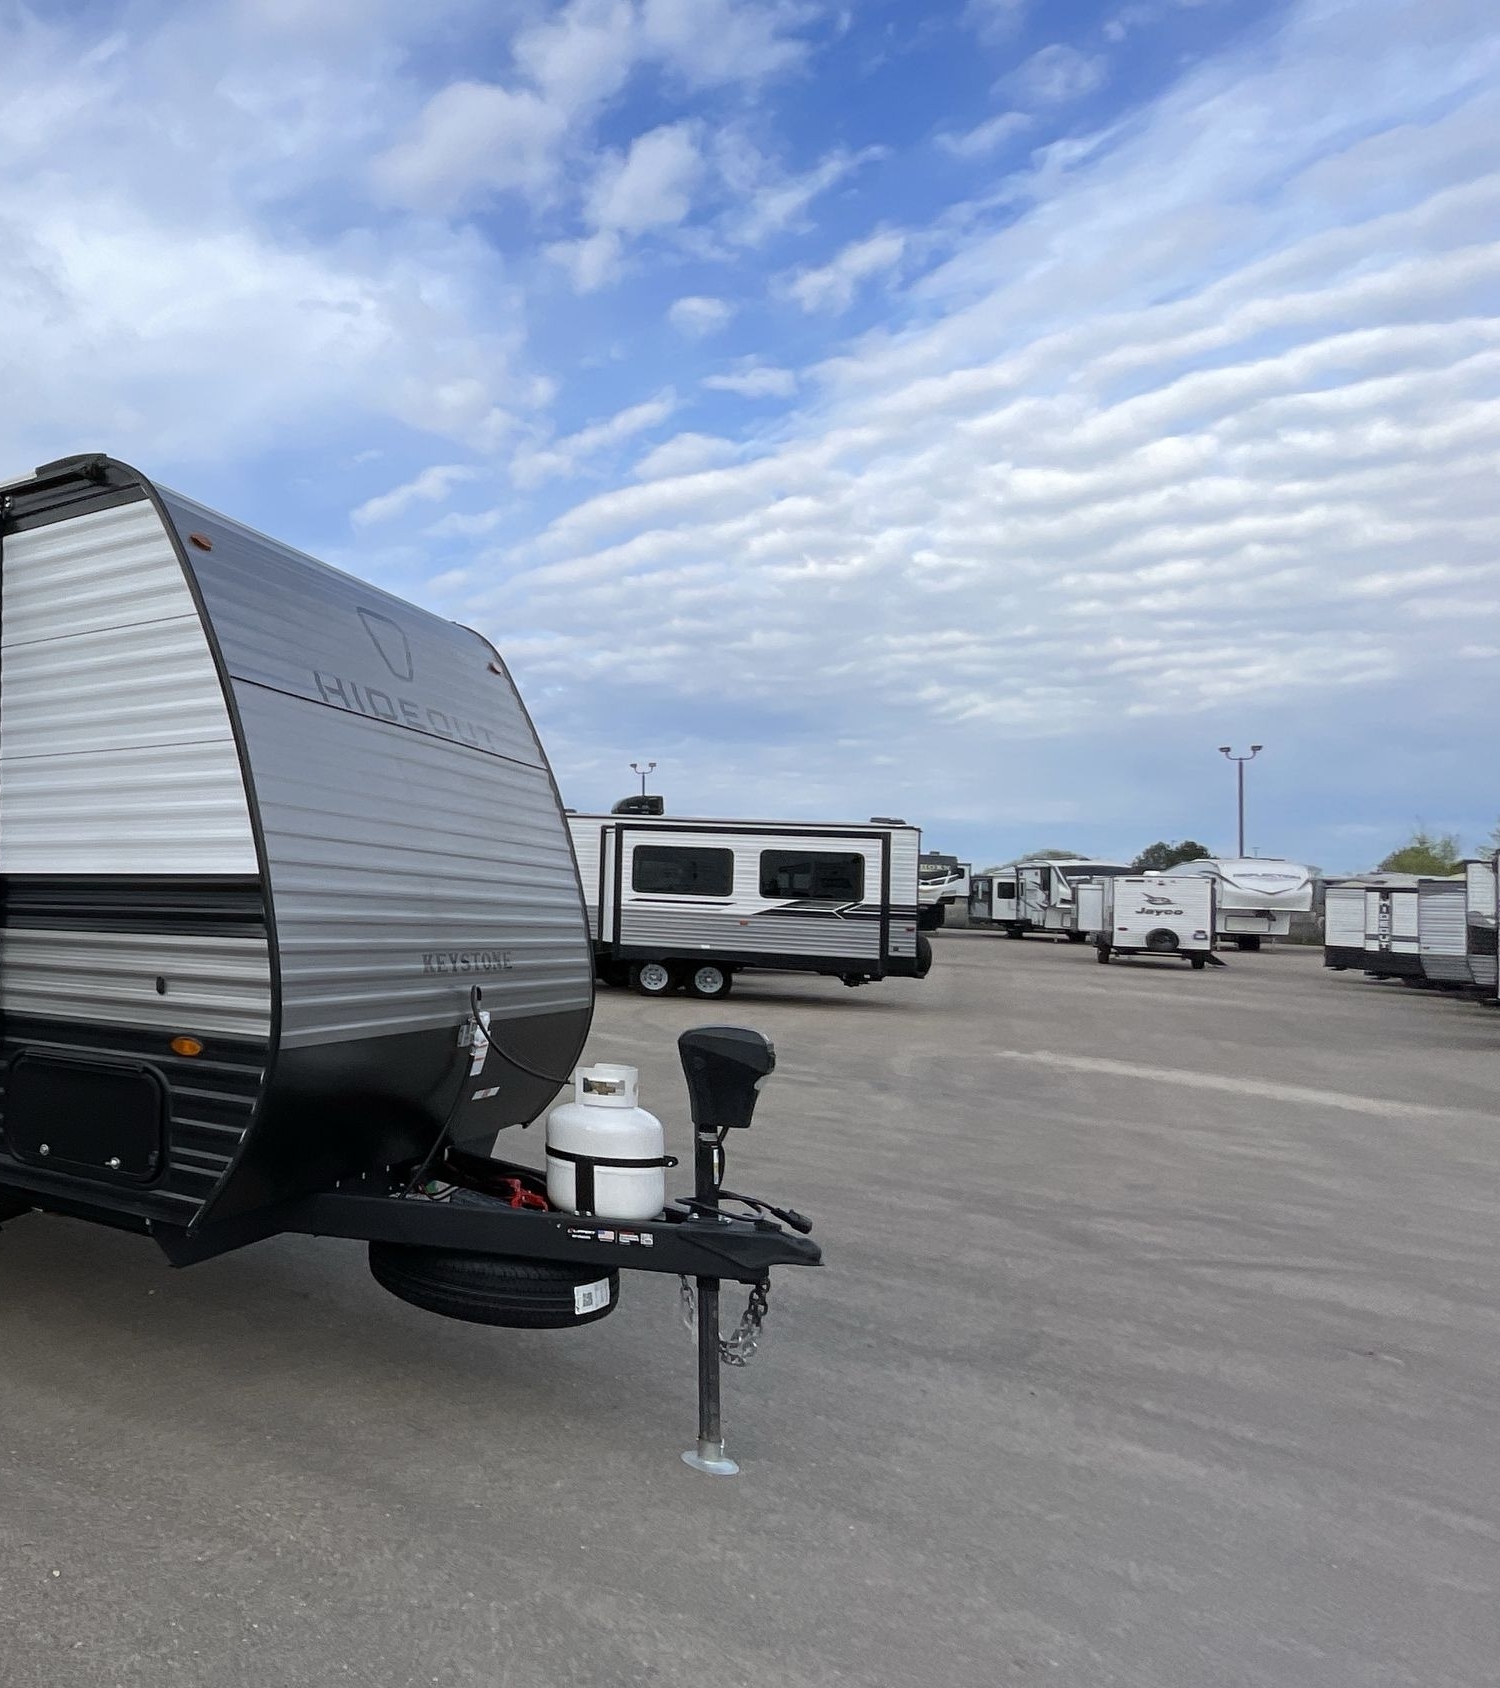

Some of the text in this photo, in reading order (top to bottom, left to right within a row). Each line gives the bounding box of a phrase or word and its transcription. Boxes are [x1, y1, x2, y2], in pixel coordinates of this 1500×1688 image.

[313, 670, 496, 750] HIDEOUT
[1135, 907, 1184, 916] Jayco
[422, 951, 513, 974] KEYSTONE
